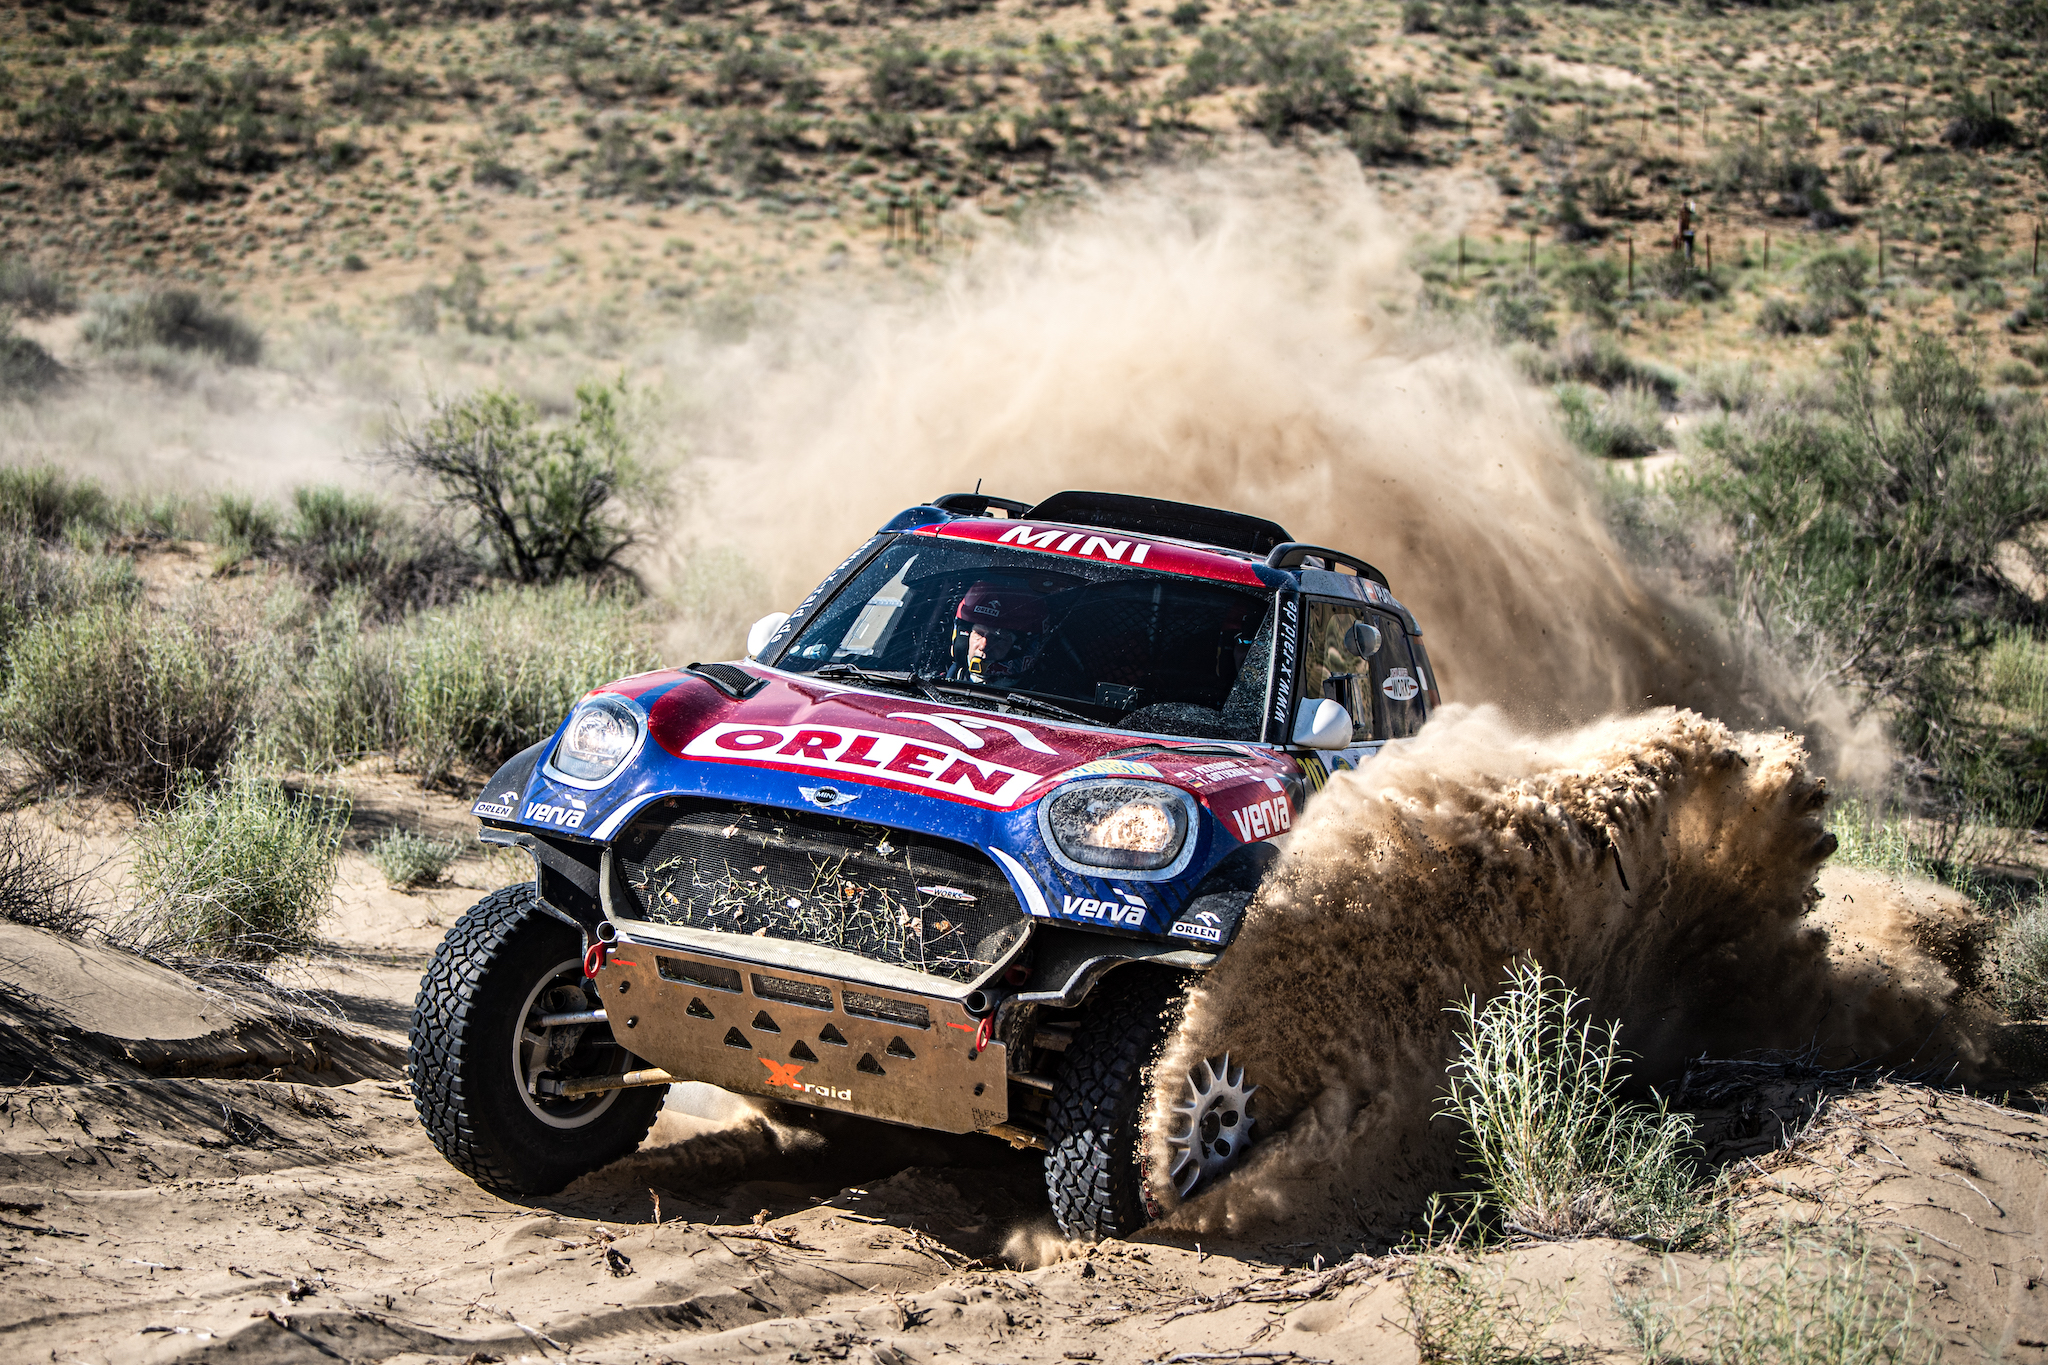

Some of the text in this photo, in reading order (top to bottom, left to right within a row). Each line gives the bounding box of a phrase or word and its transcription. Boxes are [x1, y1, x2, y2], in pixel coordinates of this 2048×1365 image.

[997, 525, 1151, 564] MINI
[1274, 600, 1298, 724] www.x-raid.de
[1391, 679, 1411, 697] WORKS
[715, 729, 1015, 795] ORLEN
[815, 791, 836, 799] MINI
[478, 804, 510, 815] ORLEN
[524, 802, 586, 828] verva
[1231, 796, 1291, 843] verva
[934, 888, 963, 899] WORKS
[1062, 895, 1147, 926] verva
[1175, 924, 1217, 939] ORLEN
